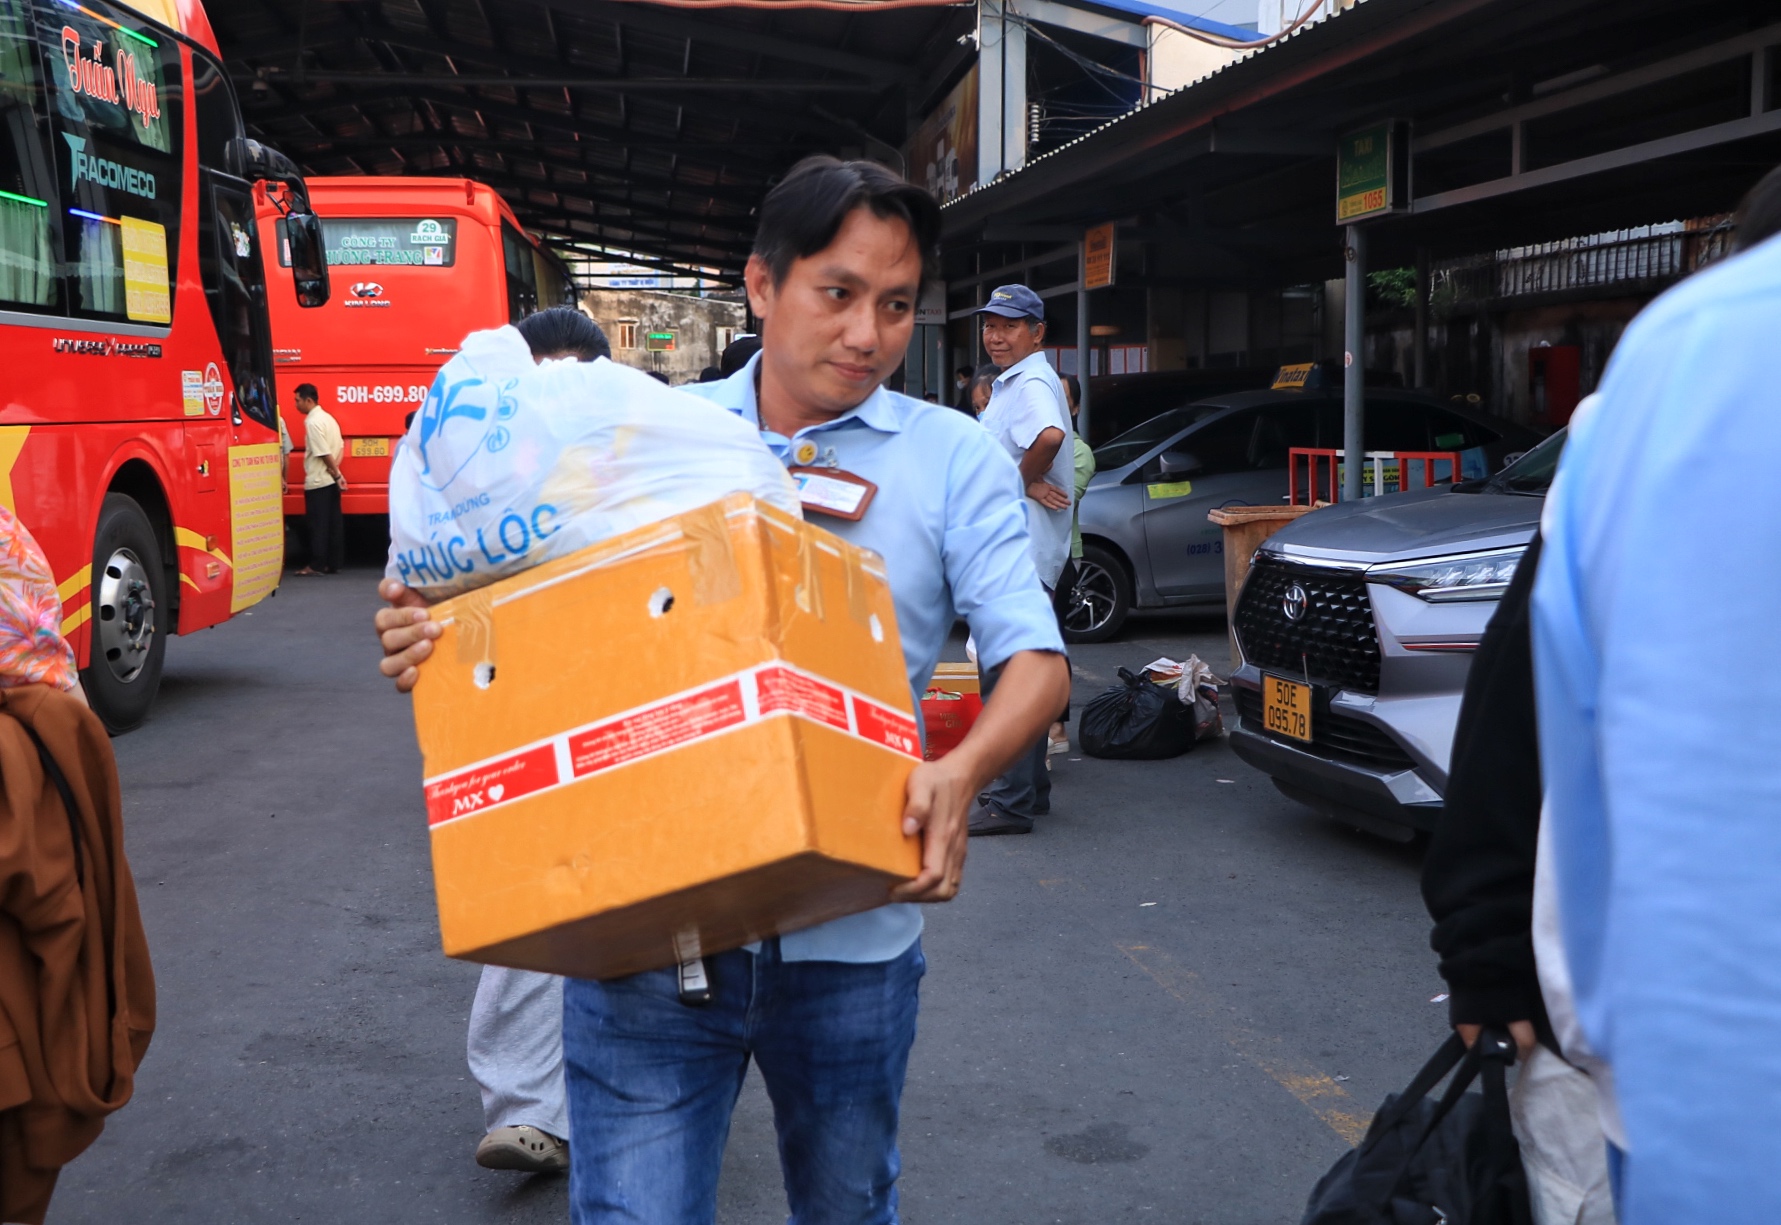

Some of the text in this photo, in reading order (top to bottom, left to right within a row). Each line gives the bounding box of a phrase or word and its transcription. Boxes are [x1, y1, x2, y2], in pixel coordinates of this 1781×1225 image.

[62, 25, 160, 129] Tuấn Nga
[1354, 137, 1373, 157] TAXI
[61, 131, 156, 199] TRACOMECO
[1364, 189, 1383, 211] 1055
[422, 222, 437, 233] 29
[341, 233, 397, 248] CÔNG TY
[326, 247, 423, 265] HƯƠNG TRANG
[337, 385, 428, 403] 50H-699.80
[355, 446, 385, 456] 699.80
[362, 438, 379, 448] 50H
[396, 503, 562, 587] PHÚC LỘC
[1187, 540, 1223, 556] (028) 3
[1276, 681, 1297, 708] 50E
[1268, 704, 1306, 737] 095.78
[453, 790, 484, 815] MX
